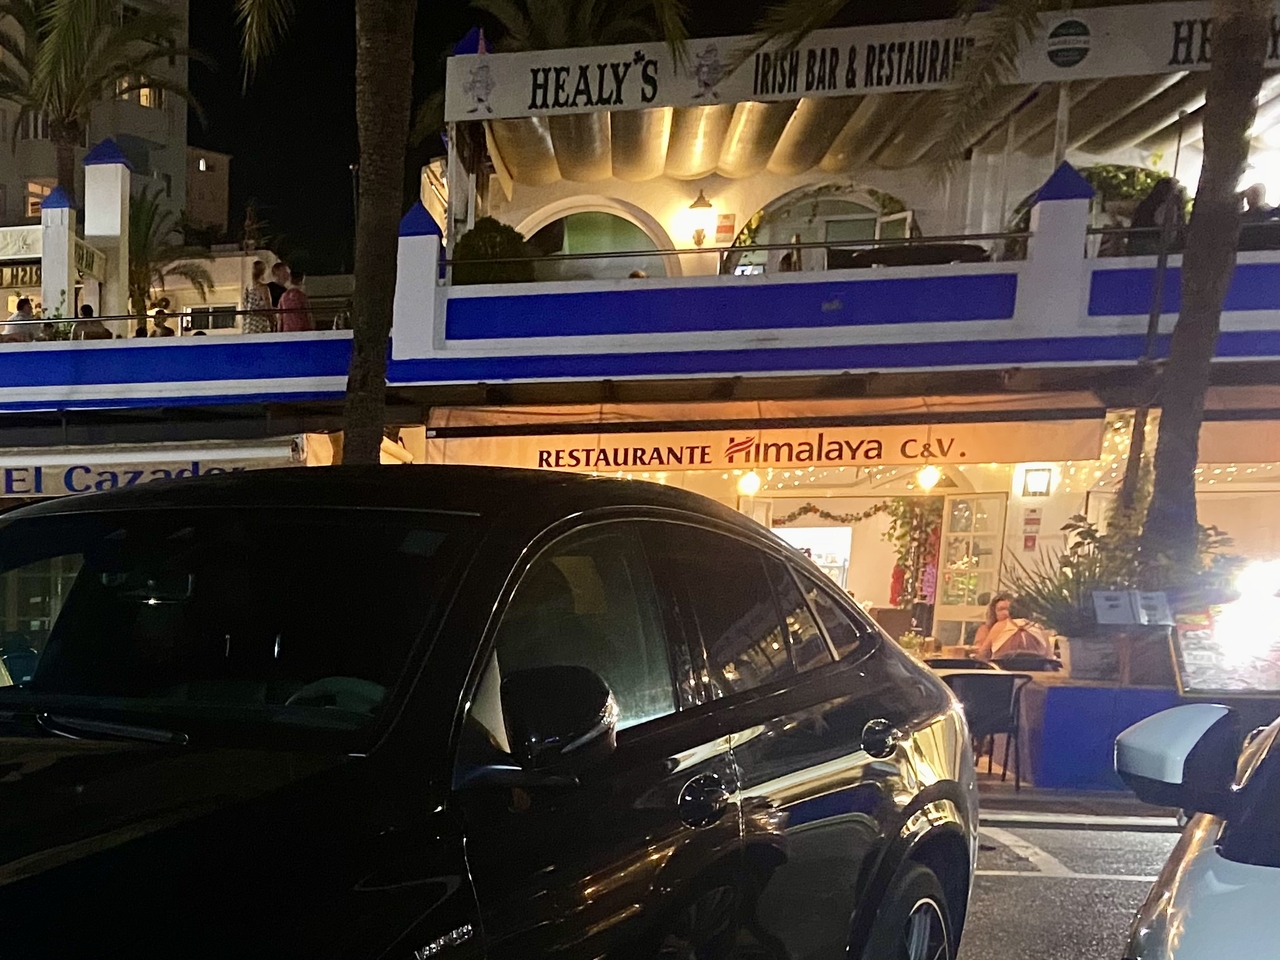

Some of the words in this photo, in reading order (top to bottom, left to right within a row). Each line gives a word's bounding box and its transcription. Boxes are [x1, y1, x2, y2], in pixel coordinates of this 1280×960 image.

[528, 50, 658, 109] HEALY'S
[753, 50, 800, 95] IRISH
[805, 47, 839, 91] BAR
[845, 45, 857, 88] &
[538, 445, 713, 468] RESTAURANTE
[4, 466, 43, 494] El
